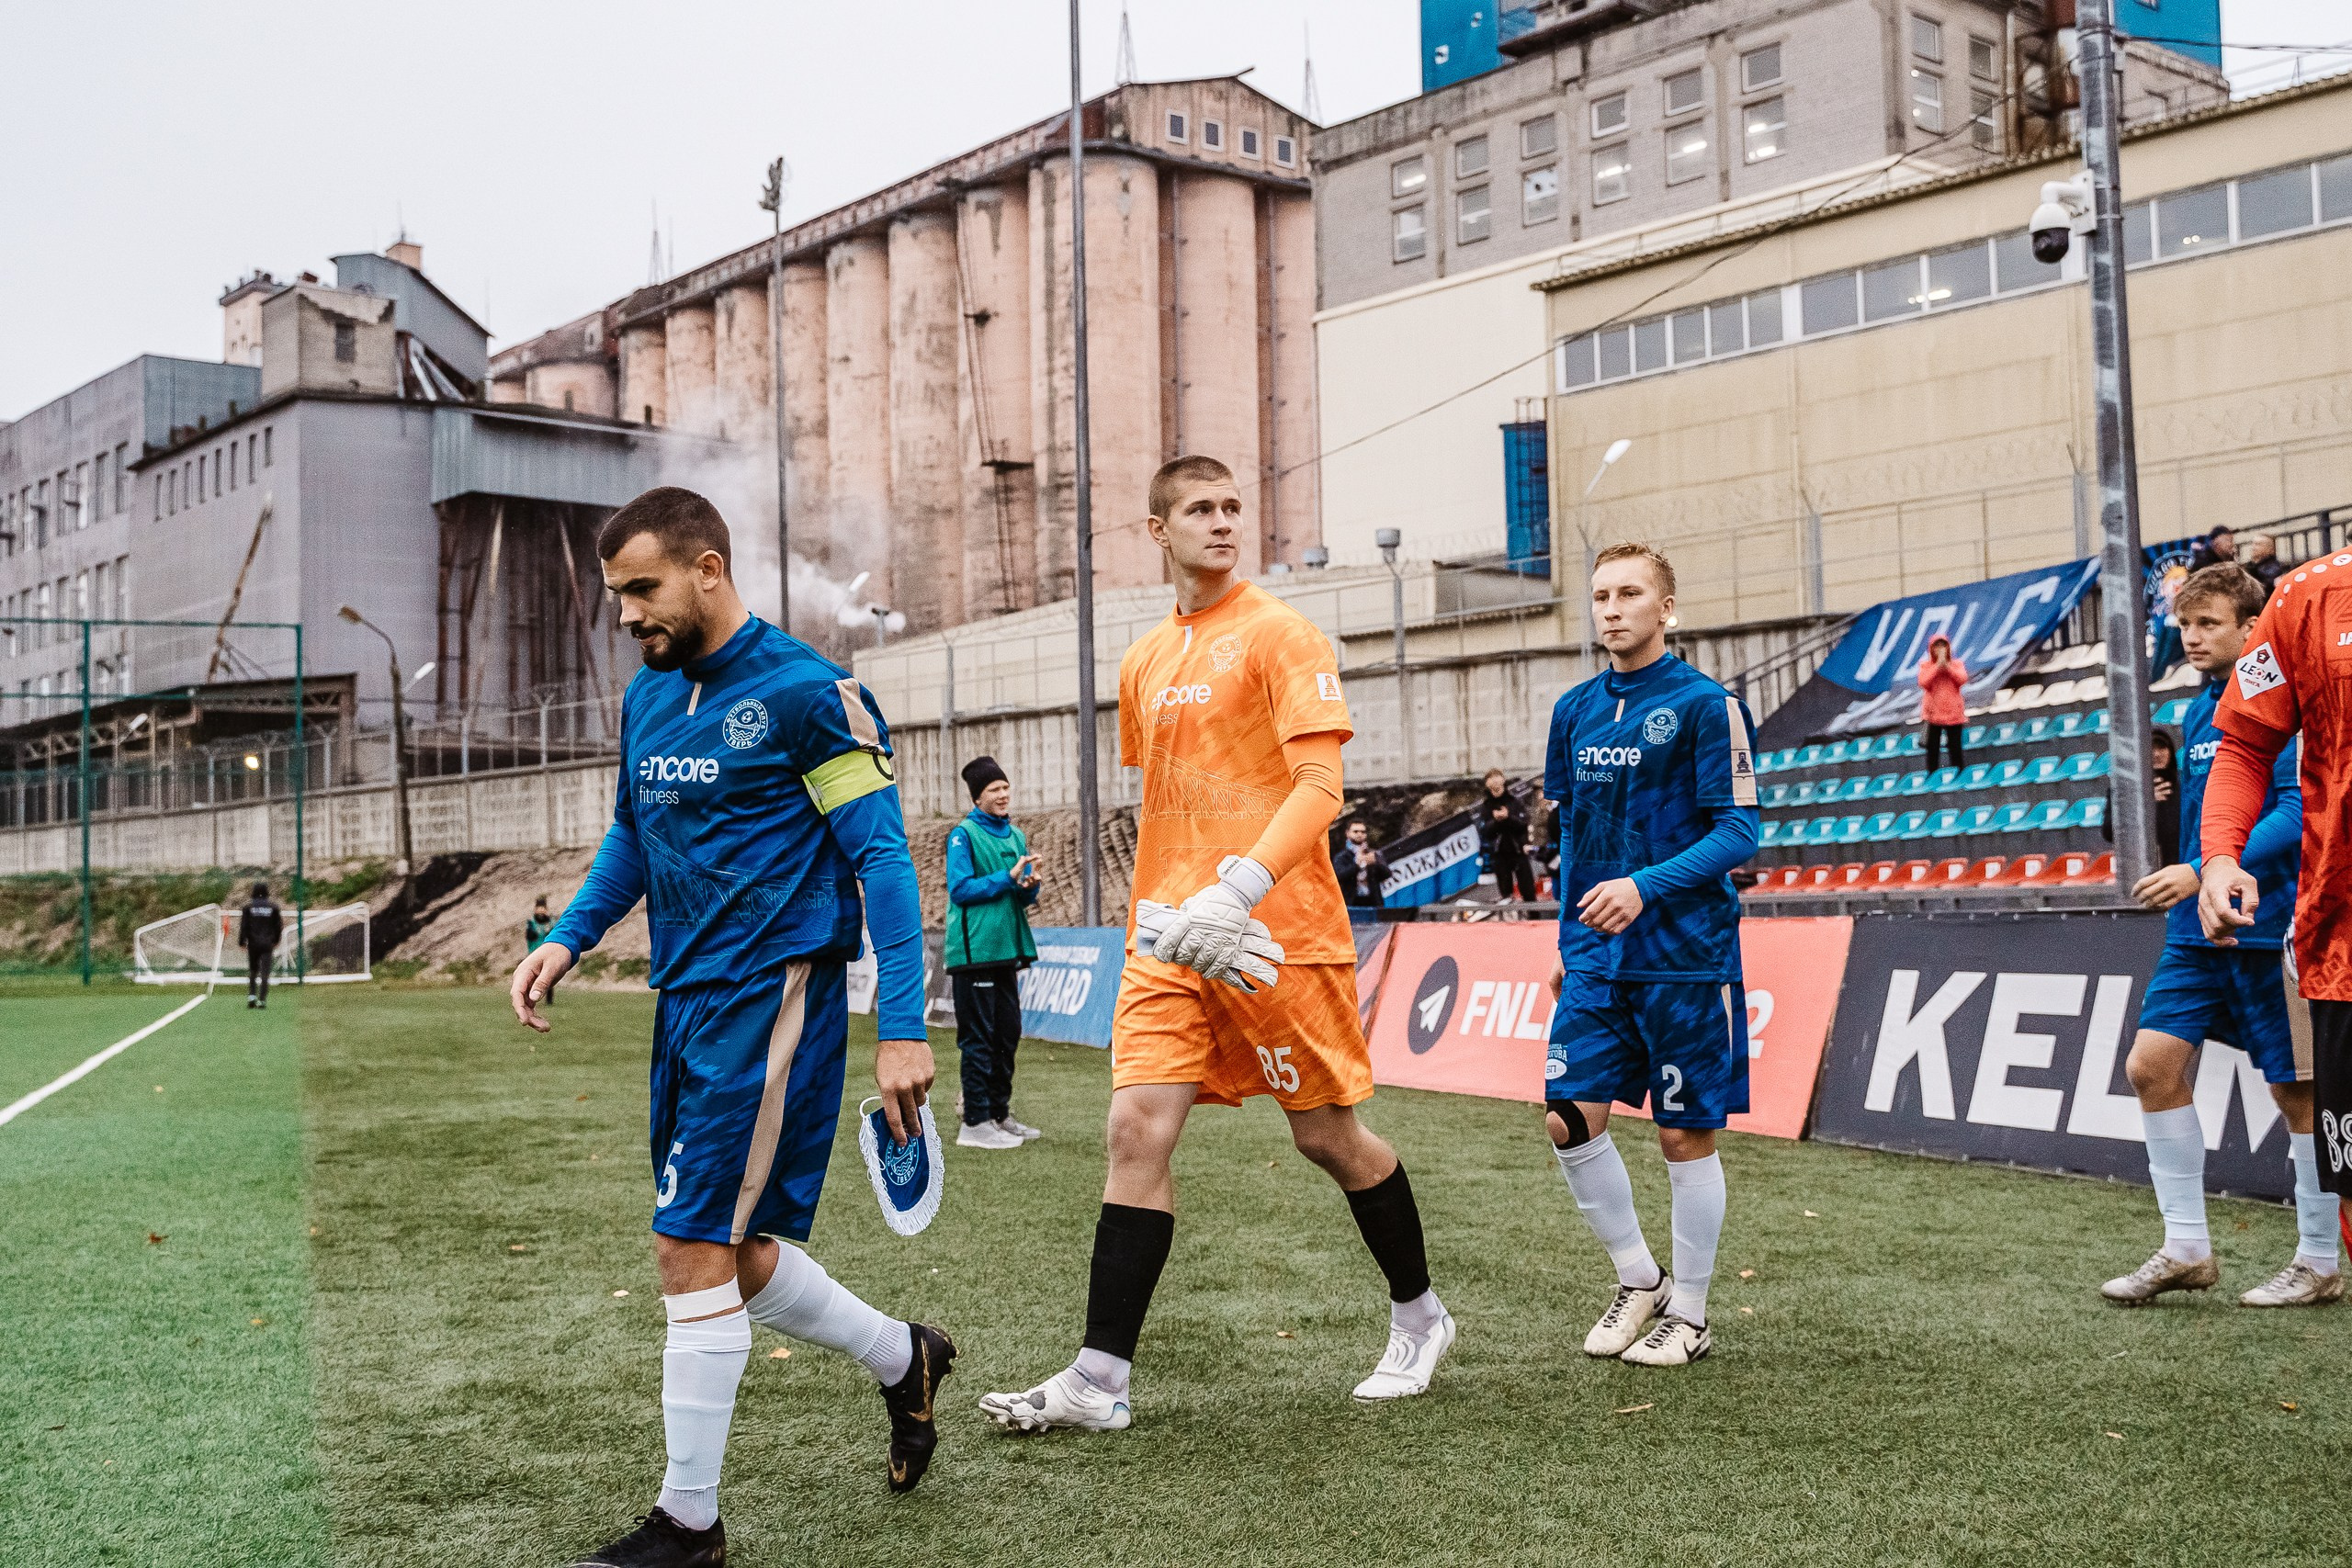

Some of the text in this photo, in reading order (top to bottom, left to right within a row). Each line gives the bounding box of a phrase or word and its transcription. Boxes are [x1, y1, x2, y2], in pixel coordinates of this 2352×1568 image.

[2239, 662, 2278, 683] LEON
[728, 736, 752, 748] ТВЕРЬ
[2189, 740, 2222, 761] encor
[1577, 746, 1642, 767] encore
[639, 755, 719, 784] encore
[1577, 767, 1614, 782] fitness
[639, 784, 680, 805] fitness
[1015, 966, 1092, 1016] ORWARD
[1459, 980, 1558, 1042] FNL
[1256, 1044, 1301, 1093] 85
[1661, 1064, 1685, 1111] 2
[656, 1141, 684, 1208] 5
